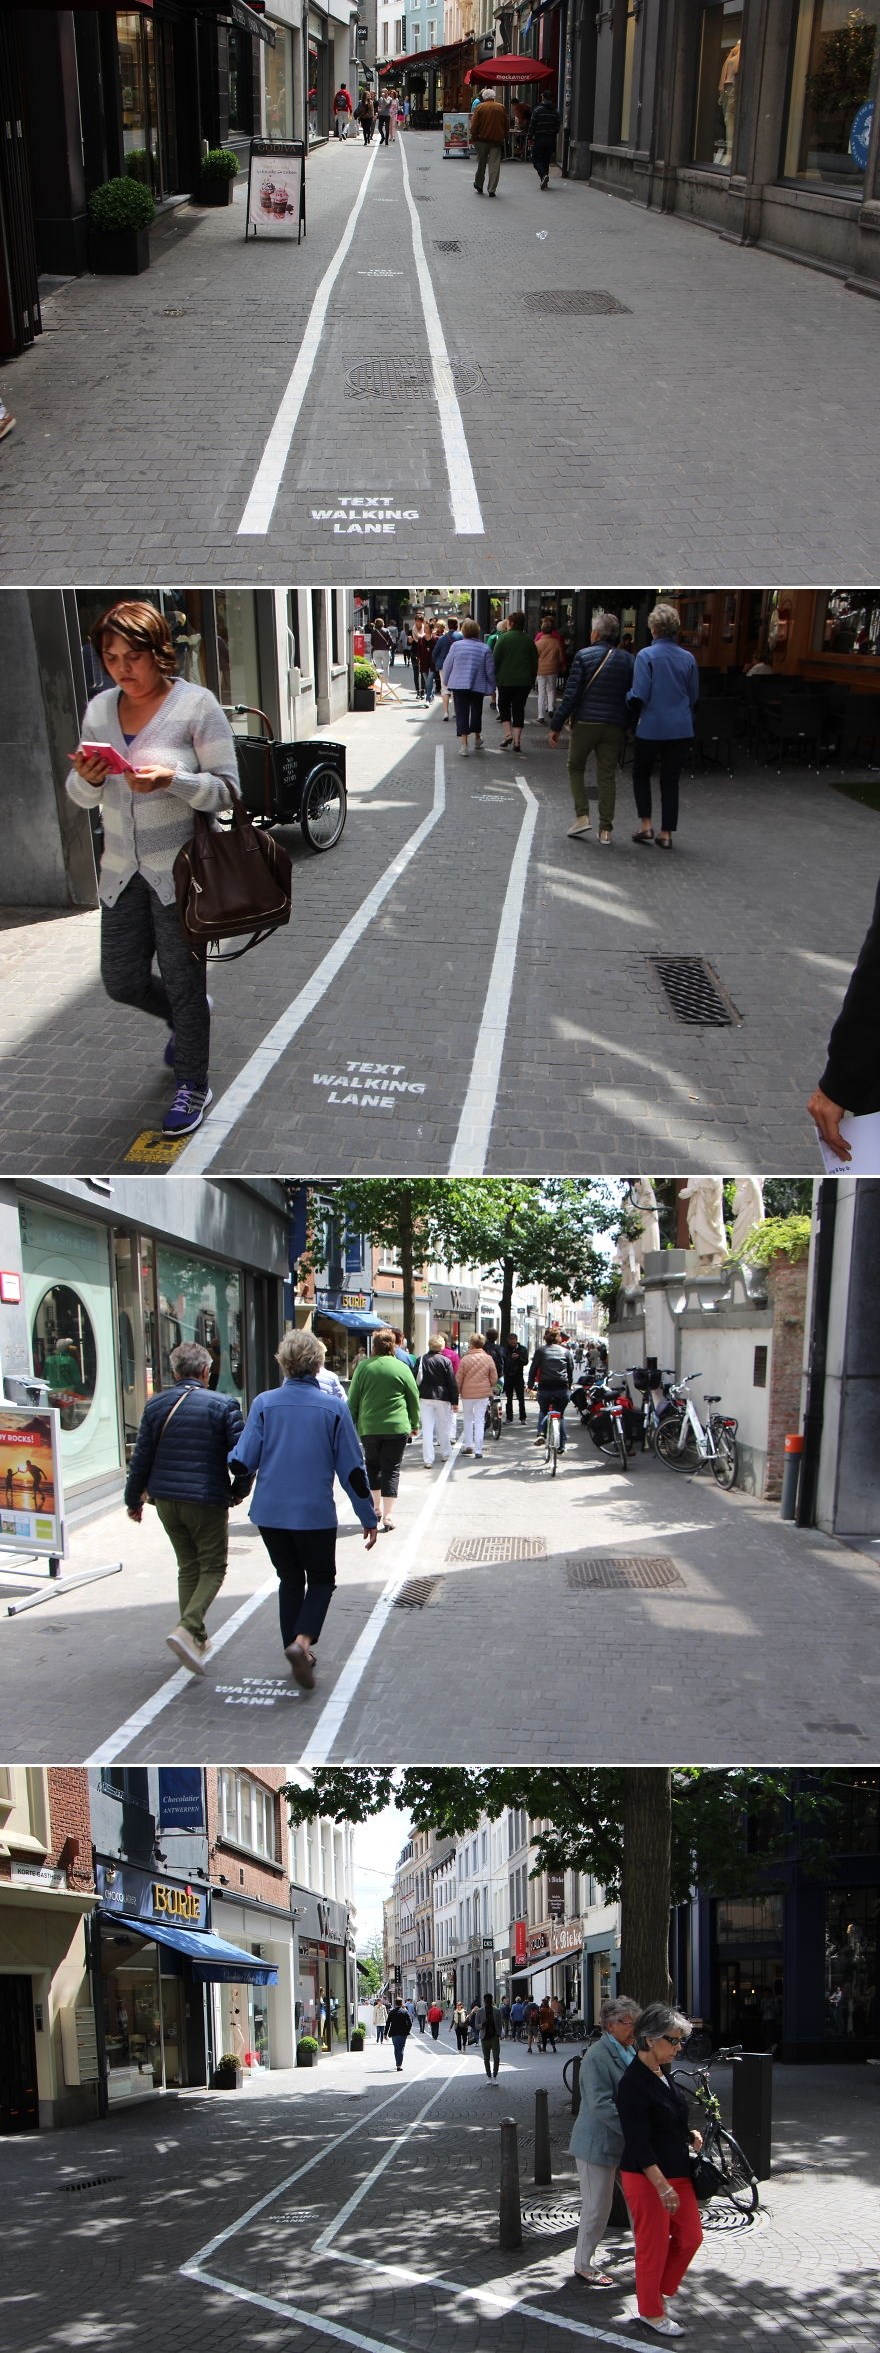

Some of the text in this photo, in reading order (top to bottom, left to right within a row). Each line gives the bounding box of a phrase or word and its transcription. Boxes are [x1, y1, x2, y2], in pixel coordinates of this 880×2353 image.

[257, 144, 297, 152] GODIVA
[337, 497, 394, 506] TEXT
[311, 510, 420, 519] WALKING
[333, 523, 396, 533] LANE
[346, 1061, 405, 1075] TEXT
[312, 1073, 427, 1094] WALKING
[327, 1091, 396, 1108] LANE
[341, 1294, 367, 1308] BURIE
[8, 1435, 34, 1443] ROCKS!
[242, 1677, 287, 1686] TEXT
[215, 1685, 300, 1696] WALKING
[224, 1695, 275, 1705] LANE
[163, 1794, 199, 1803] Chocolatier
[17, 1868, 36, 1876] KORTE
[153, 1882, 200, 1919] BURIE
[560, 1930, 583, 1949] Bieke
